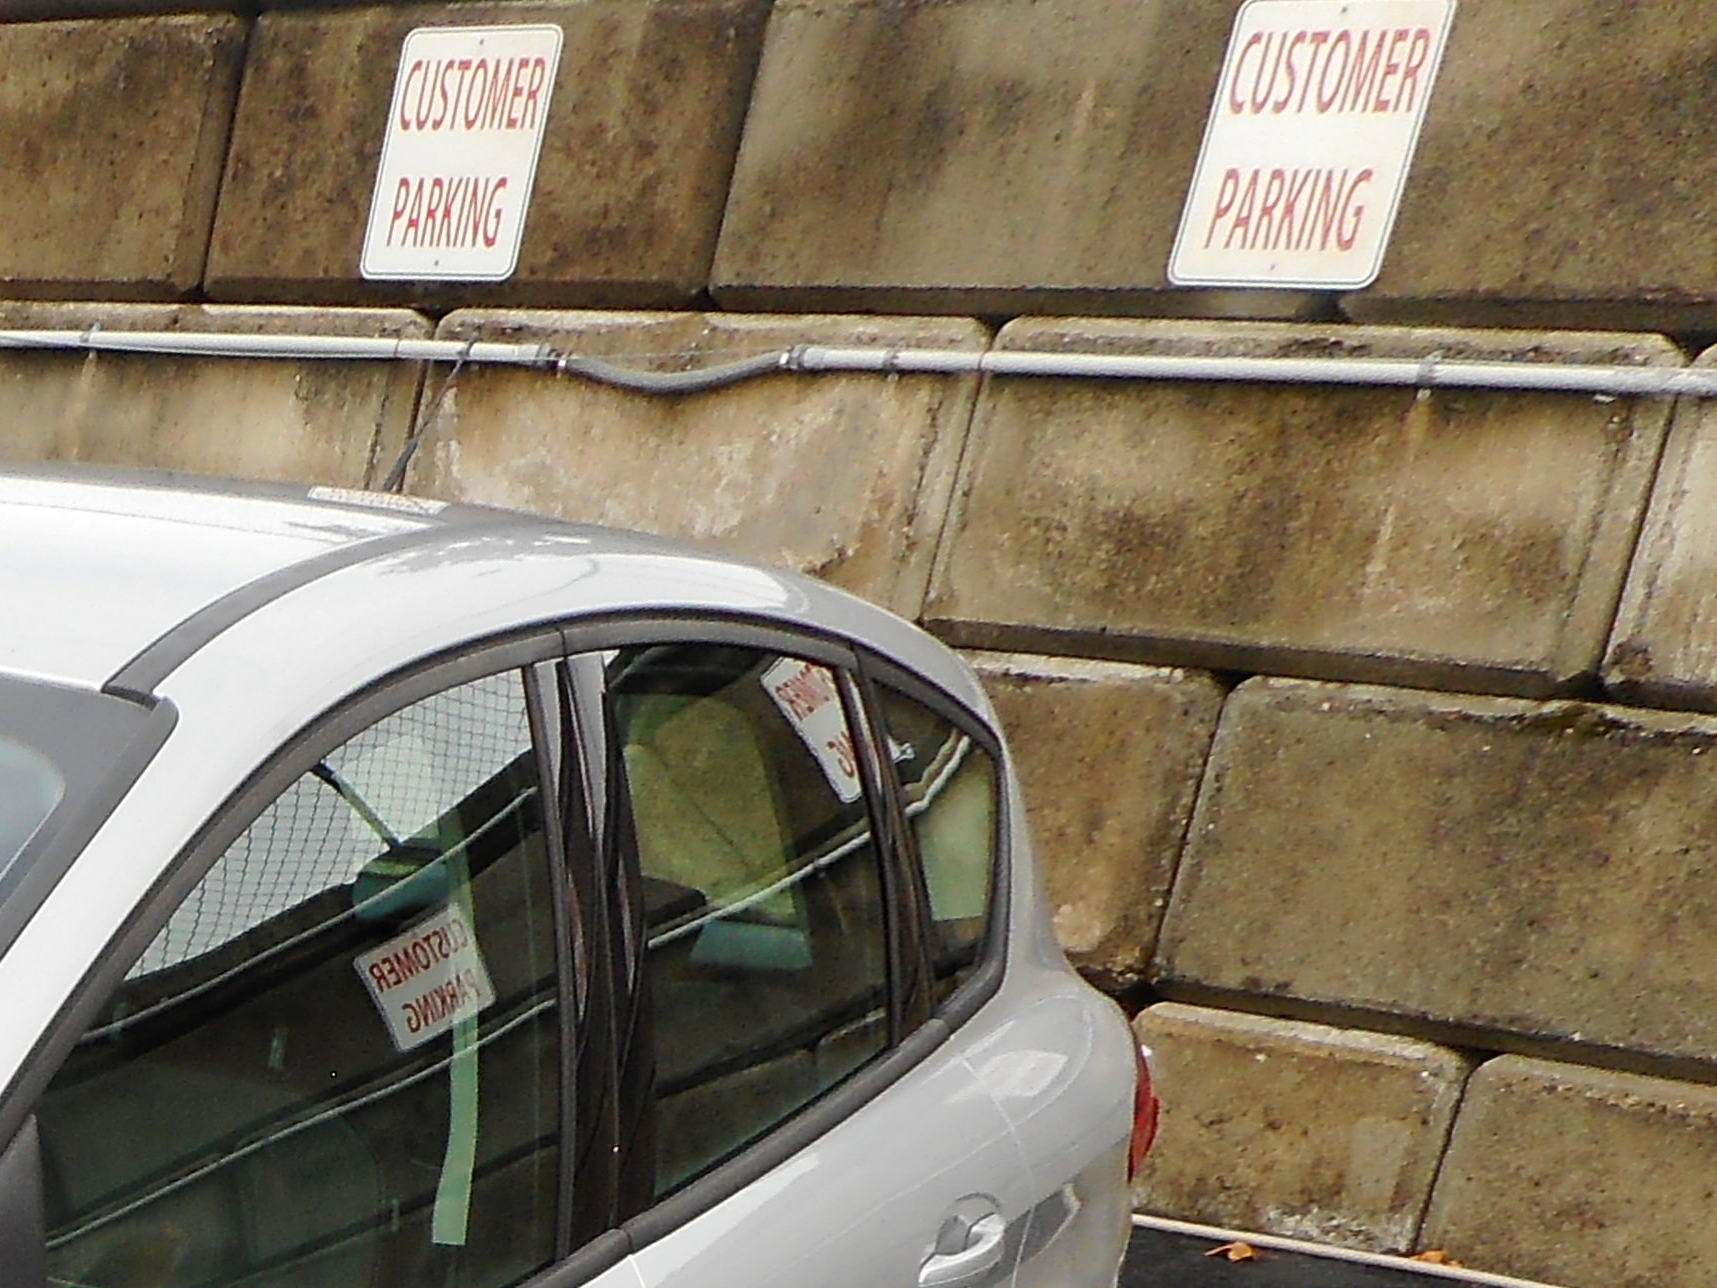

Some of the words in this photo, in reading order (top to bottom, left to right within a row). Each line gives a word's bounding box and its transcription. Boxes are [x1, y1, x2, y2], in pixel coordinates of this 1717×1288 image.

[399, 57, 546, 131] CUSTOMER
[1228, 28, 1431, 115] CUSTOMER
[385, 176, 508, 248] PARKING
[1203, 167, 1374, 252] PARKING
